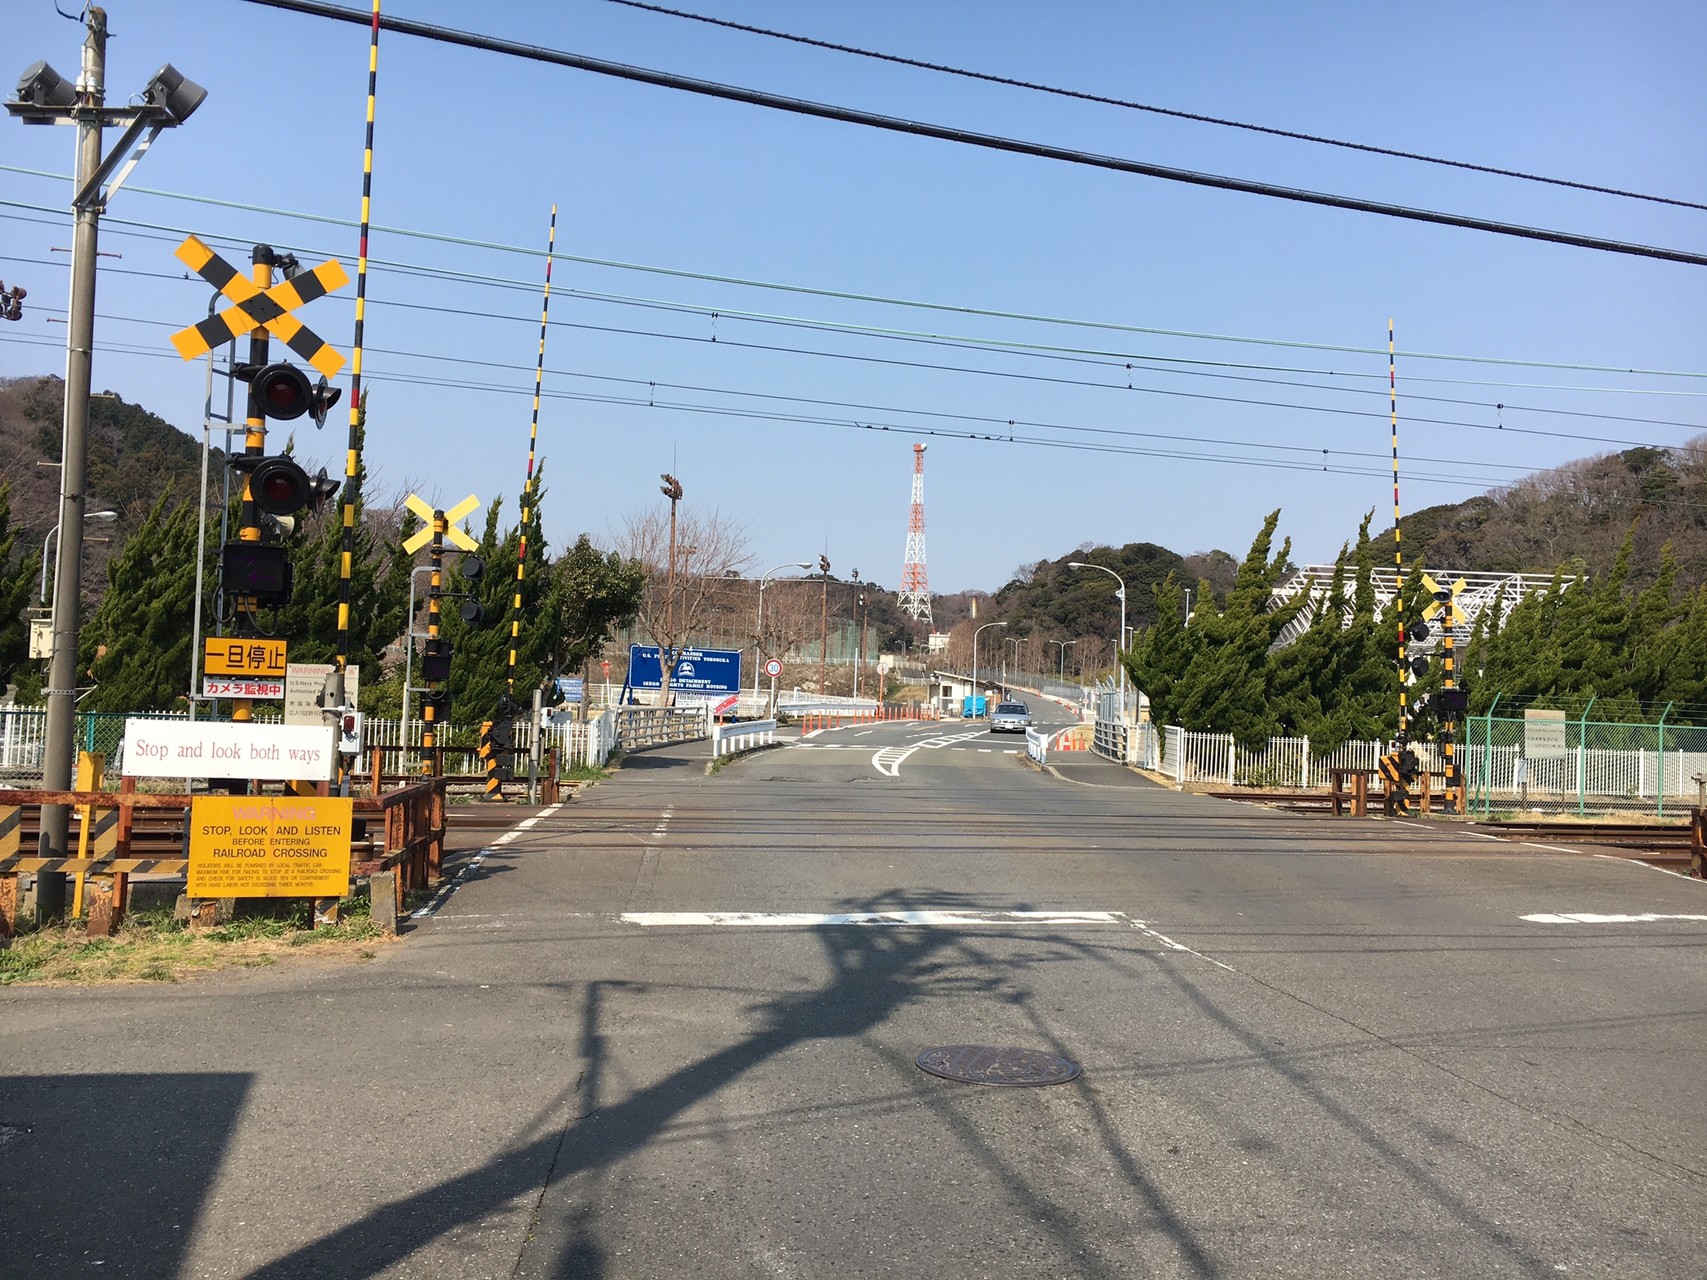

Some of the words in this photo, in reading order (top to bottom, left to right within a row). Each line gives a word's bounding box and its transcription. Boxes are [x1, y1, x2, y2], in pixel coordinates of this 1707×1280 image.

[206, 645, 285, 669] 一旦停止
[291, 667, 330, 675] WARNING
[769, 663, 779, 672] 30
[207, 682, 281, 695] カメラ監視中
[135, 738, 169, 760] Stop
[177, 741, 203, 758] and
[211, 742, 242, 759] look
[250, 743, 280, 760] both
[289, 748, 321, 764] ways
[232, 806, 316, 821] WARNING
[202, 826, 232, 836] STOP,
[239, 826, 268, 835] LOOK
[276, 826, 298, 835] AND
[305, 826, 341, 835] LISTEN
[213, 849, 266, 858] RAILROAD
[273, 849, 328, 858] CROSSING
